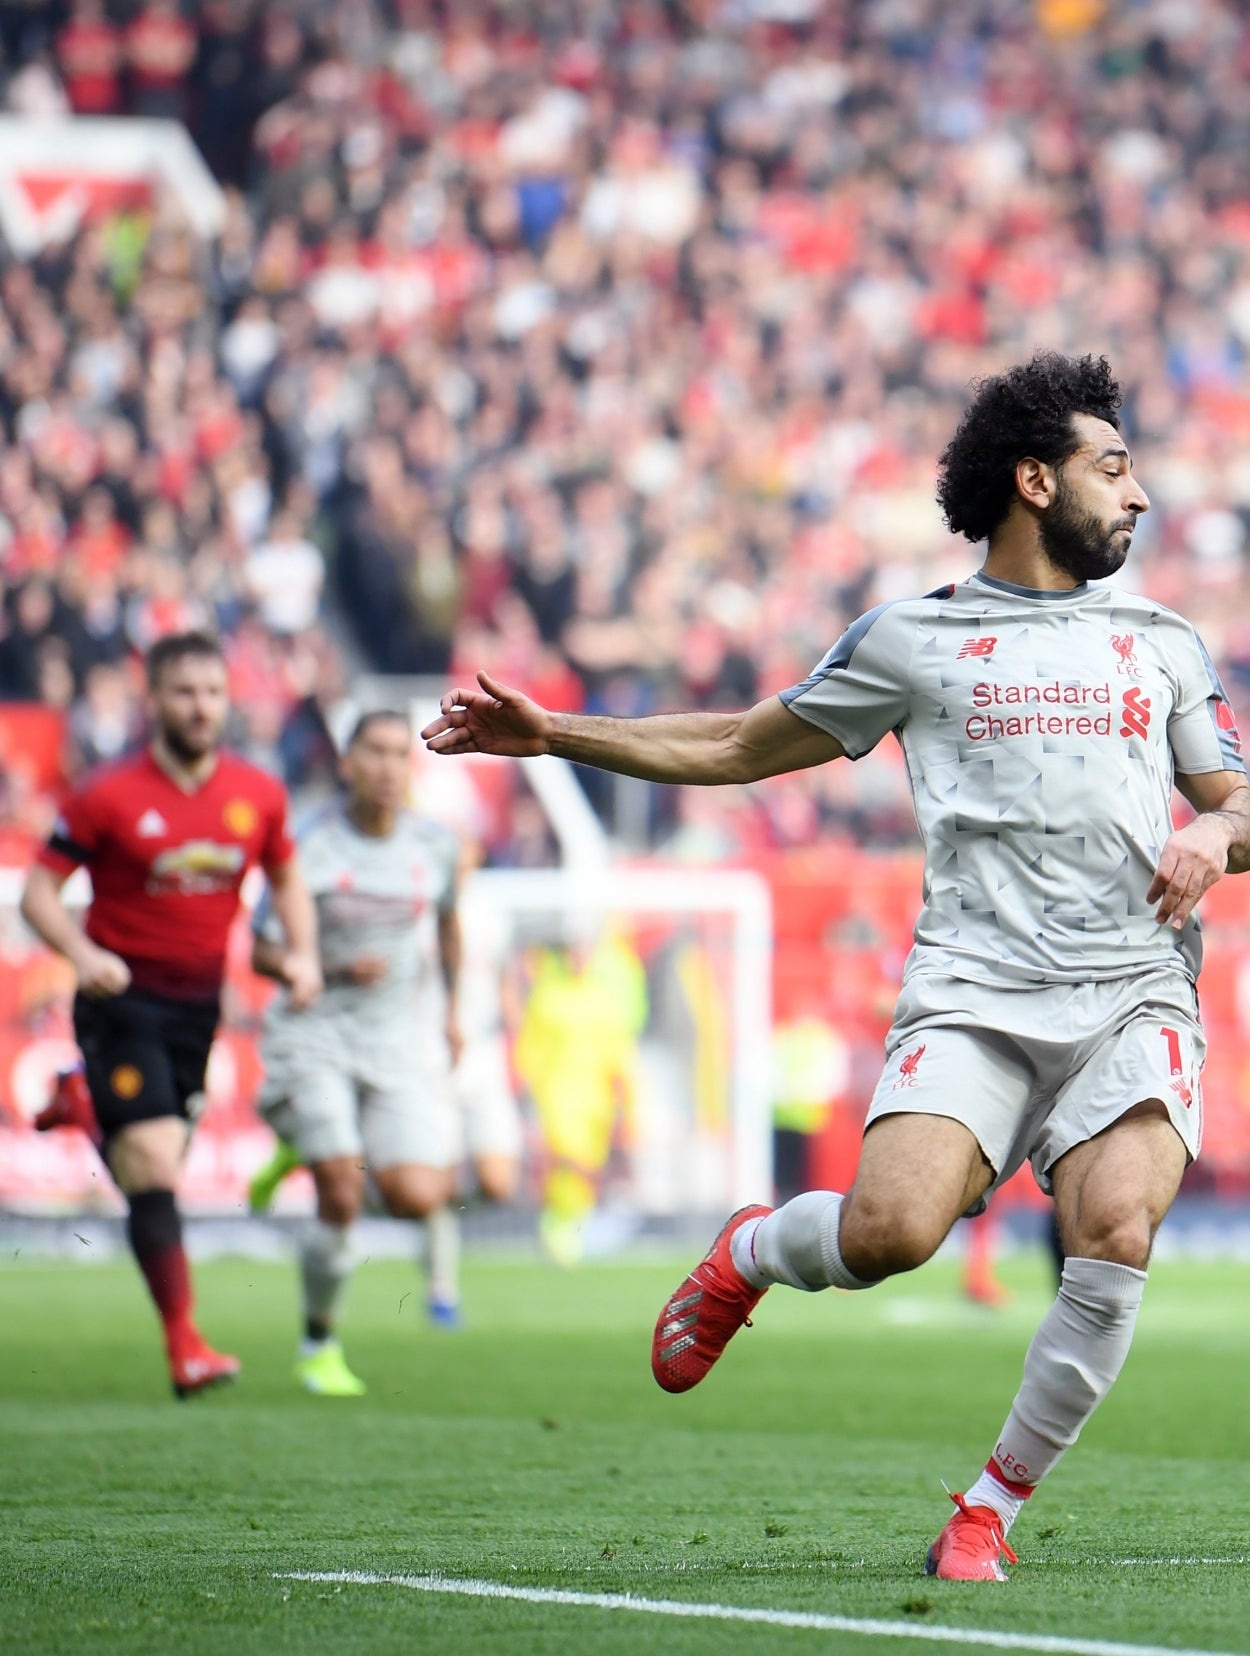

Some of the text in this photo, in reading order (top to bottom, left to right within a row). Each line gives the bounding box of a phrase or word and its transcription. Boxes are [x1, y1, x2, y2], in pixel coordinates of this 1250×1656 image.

[1116, 664, 1145, 679] LFC
[972, 681, 1111, 707] Standard
[965, 711, 1111, 740] Chartered
